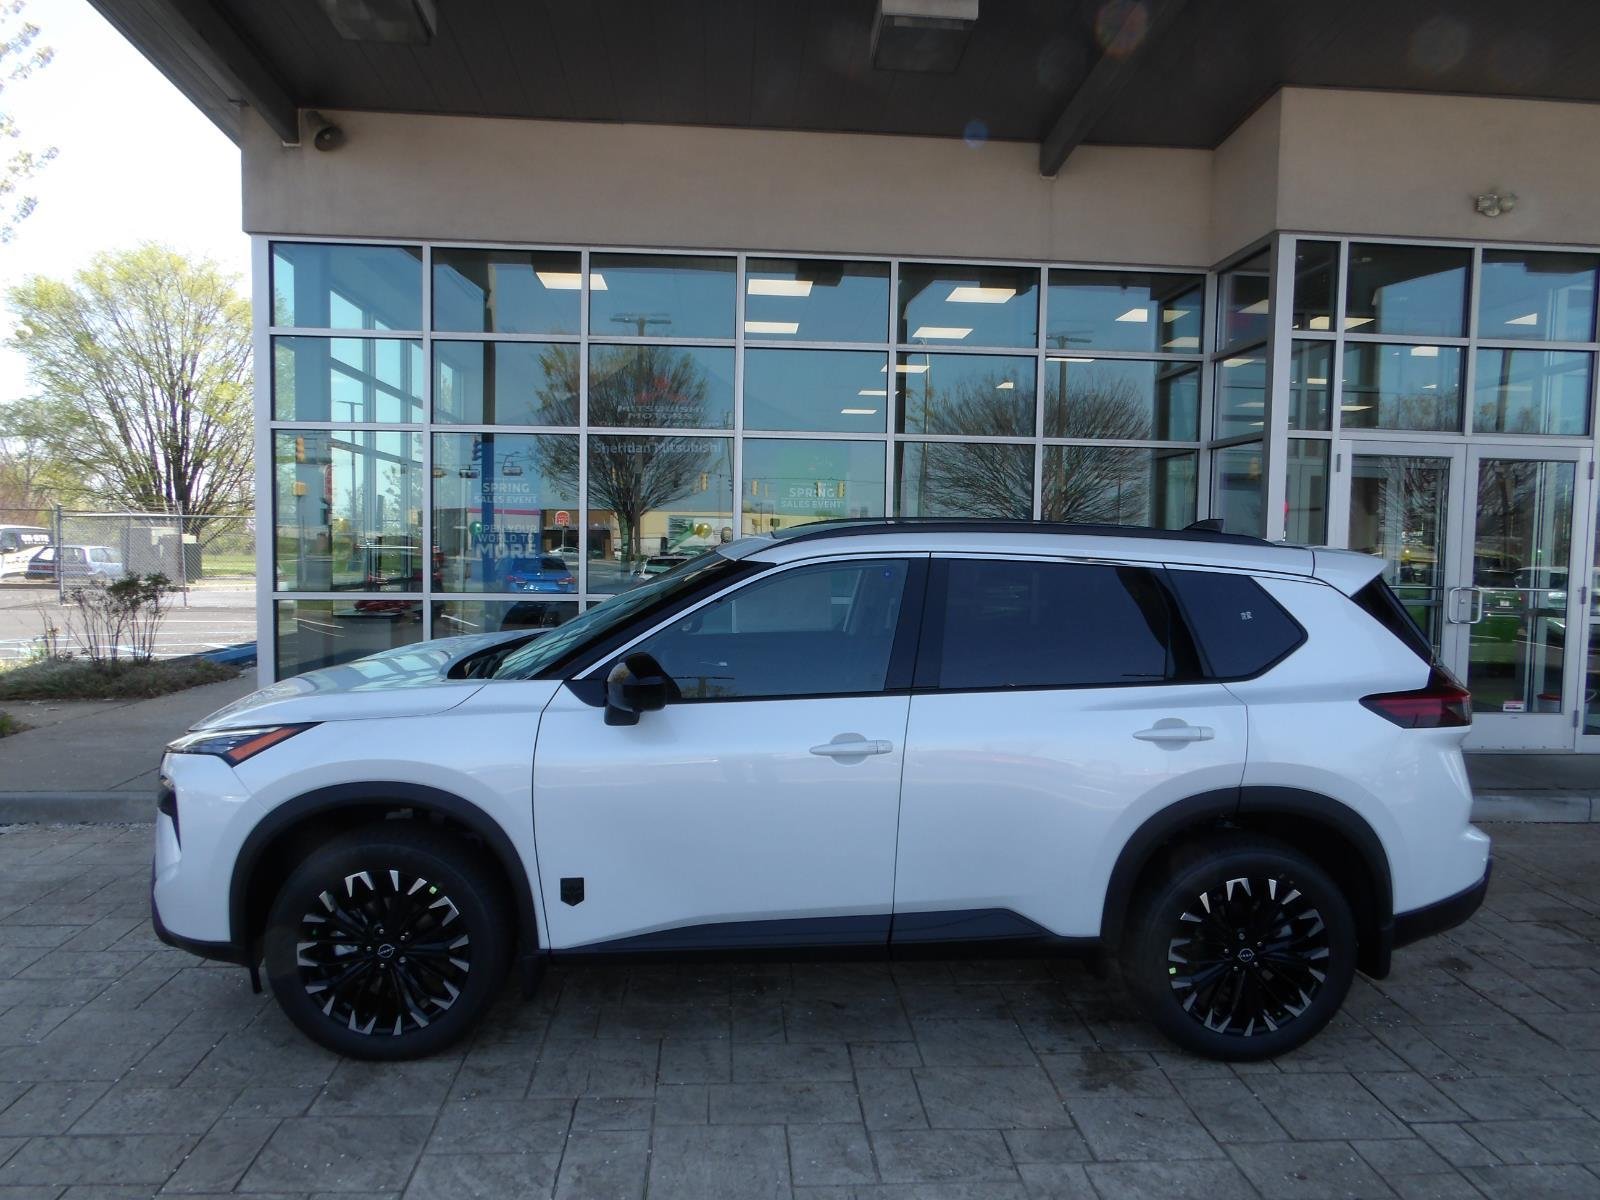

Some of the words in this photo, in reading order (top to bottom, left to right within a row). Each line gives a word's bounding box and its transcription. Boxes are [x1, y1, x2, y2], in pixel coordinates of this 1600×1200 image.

[483, 482, 530, 493] SPRING
[789, 487, 835, 498] SPRING
[781, 500, 810, 508] SALES
[811, 500, 844, 509] EVENT
[475, 543, 537, 559] MORE
